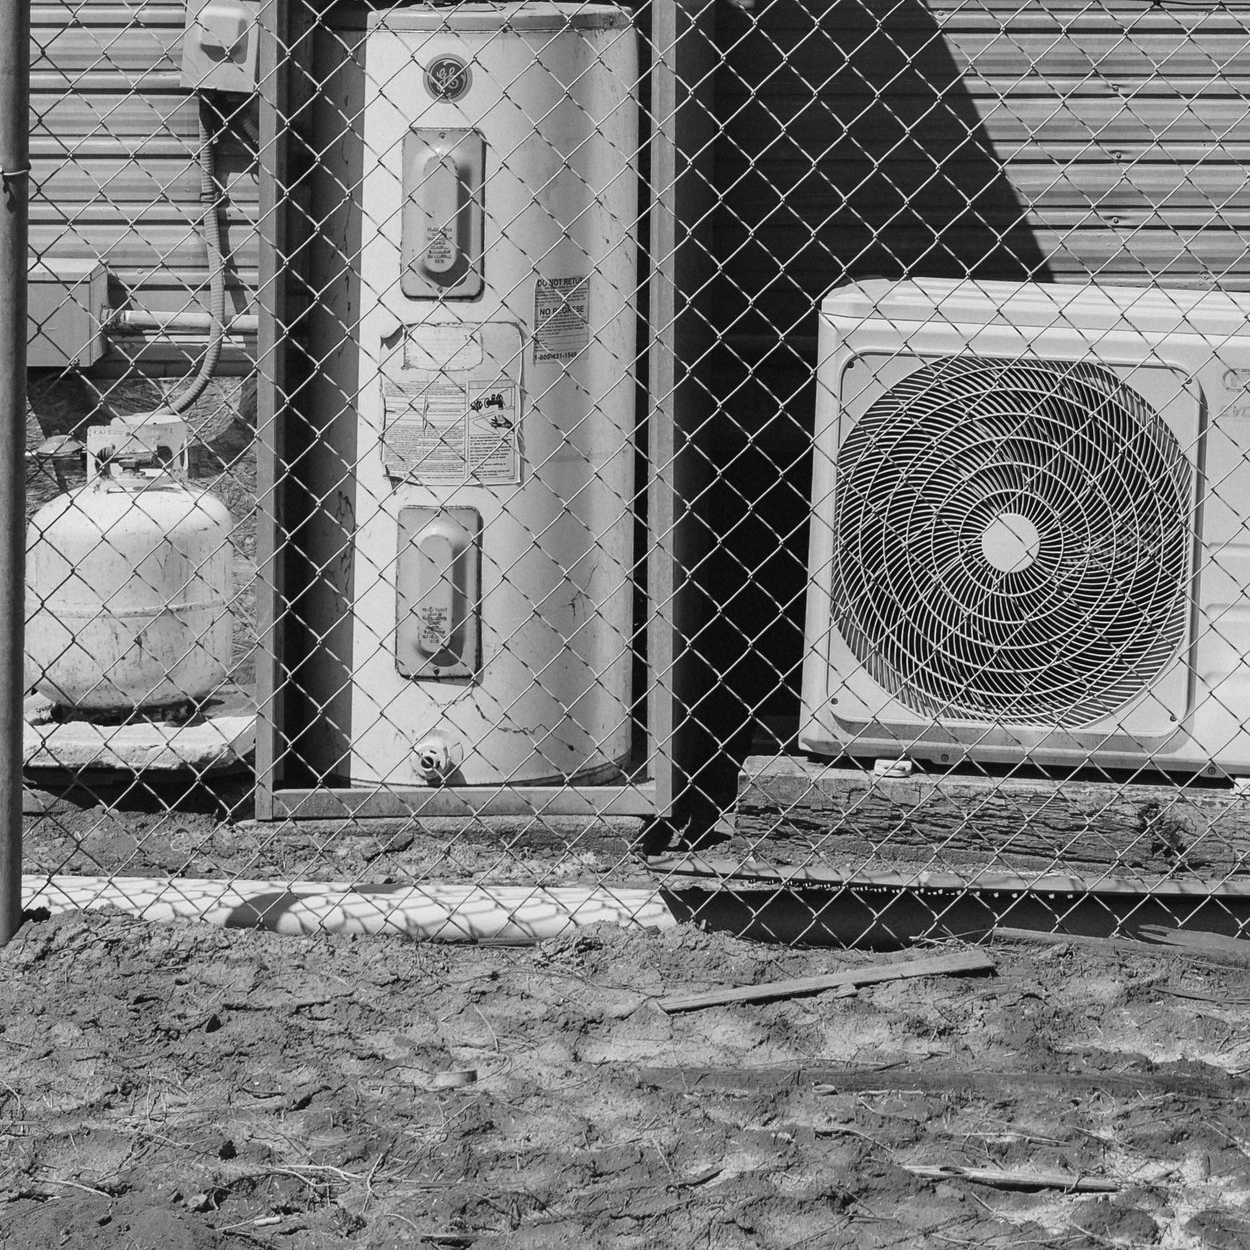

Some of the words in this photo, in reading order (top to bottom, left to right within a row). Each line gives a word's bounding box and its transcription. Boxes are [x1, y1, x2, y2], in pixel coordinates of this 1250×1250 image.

[537, 279, 547, 287] DO
[548, 278, 562, 286] NOT
[539, 308, 551, 316] NO
